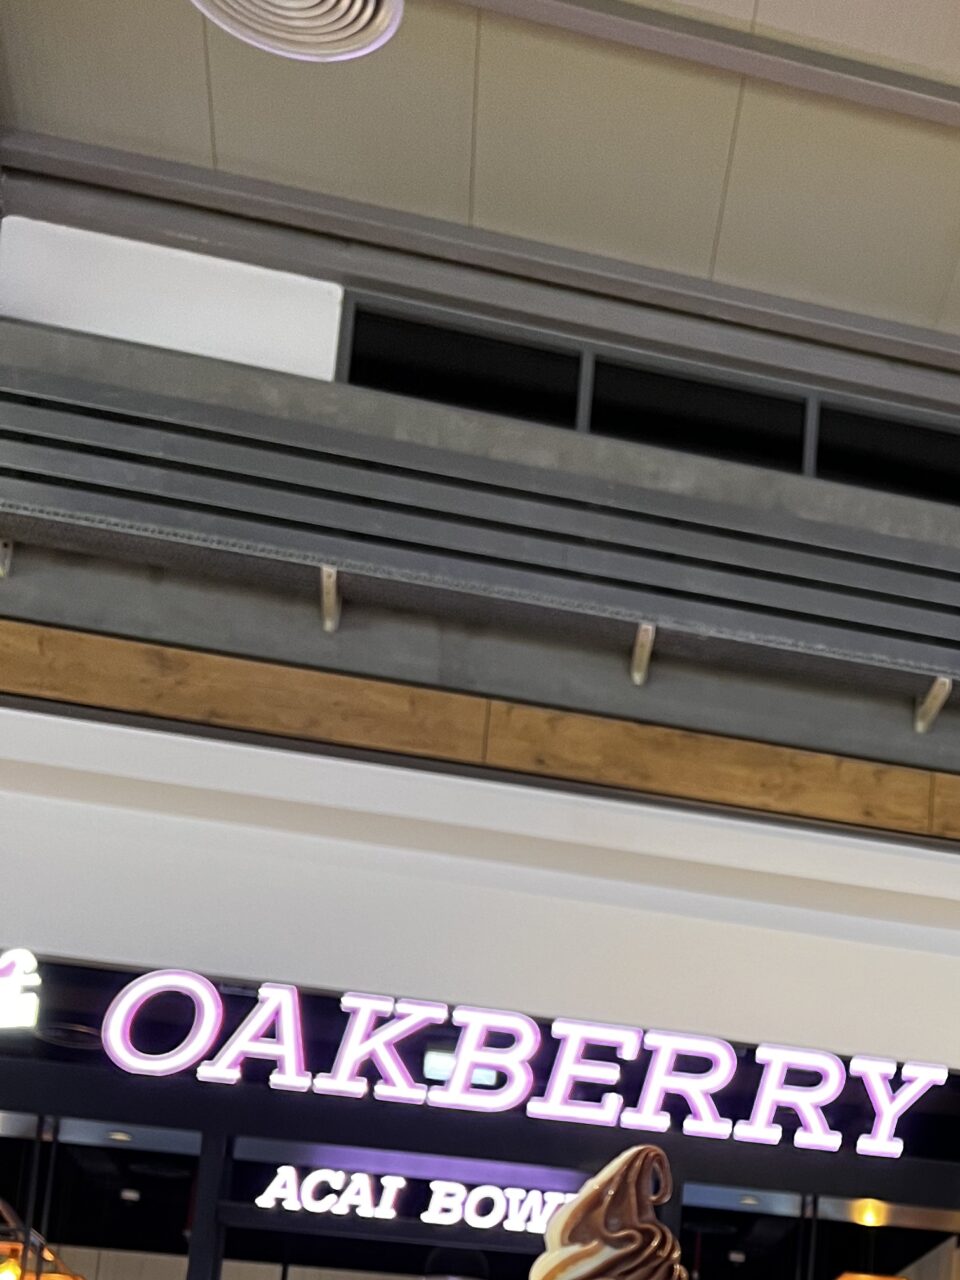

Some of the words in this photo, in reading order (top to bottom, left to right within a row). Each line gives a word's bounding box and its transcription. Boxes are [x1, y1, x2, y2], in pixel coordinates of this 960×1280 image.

[101, 968, 949, 1159] OAKBERRY
[254, 1164, 407, 1220] ACAI
[419, 1179, 579, 1235] BOW
